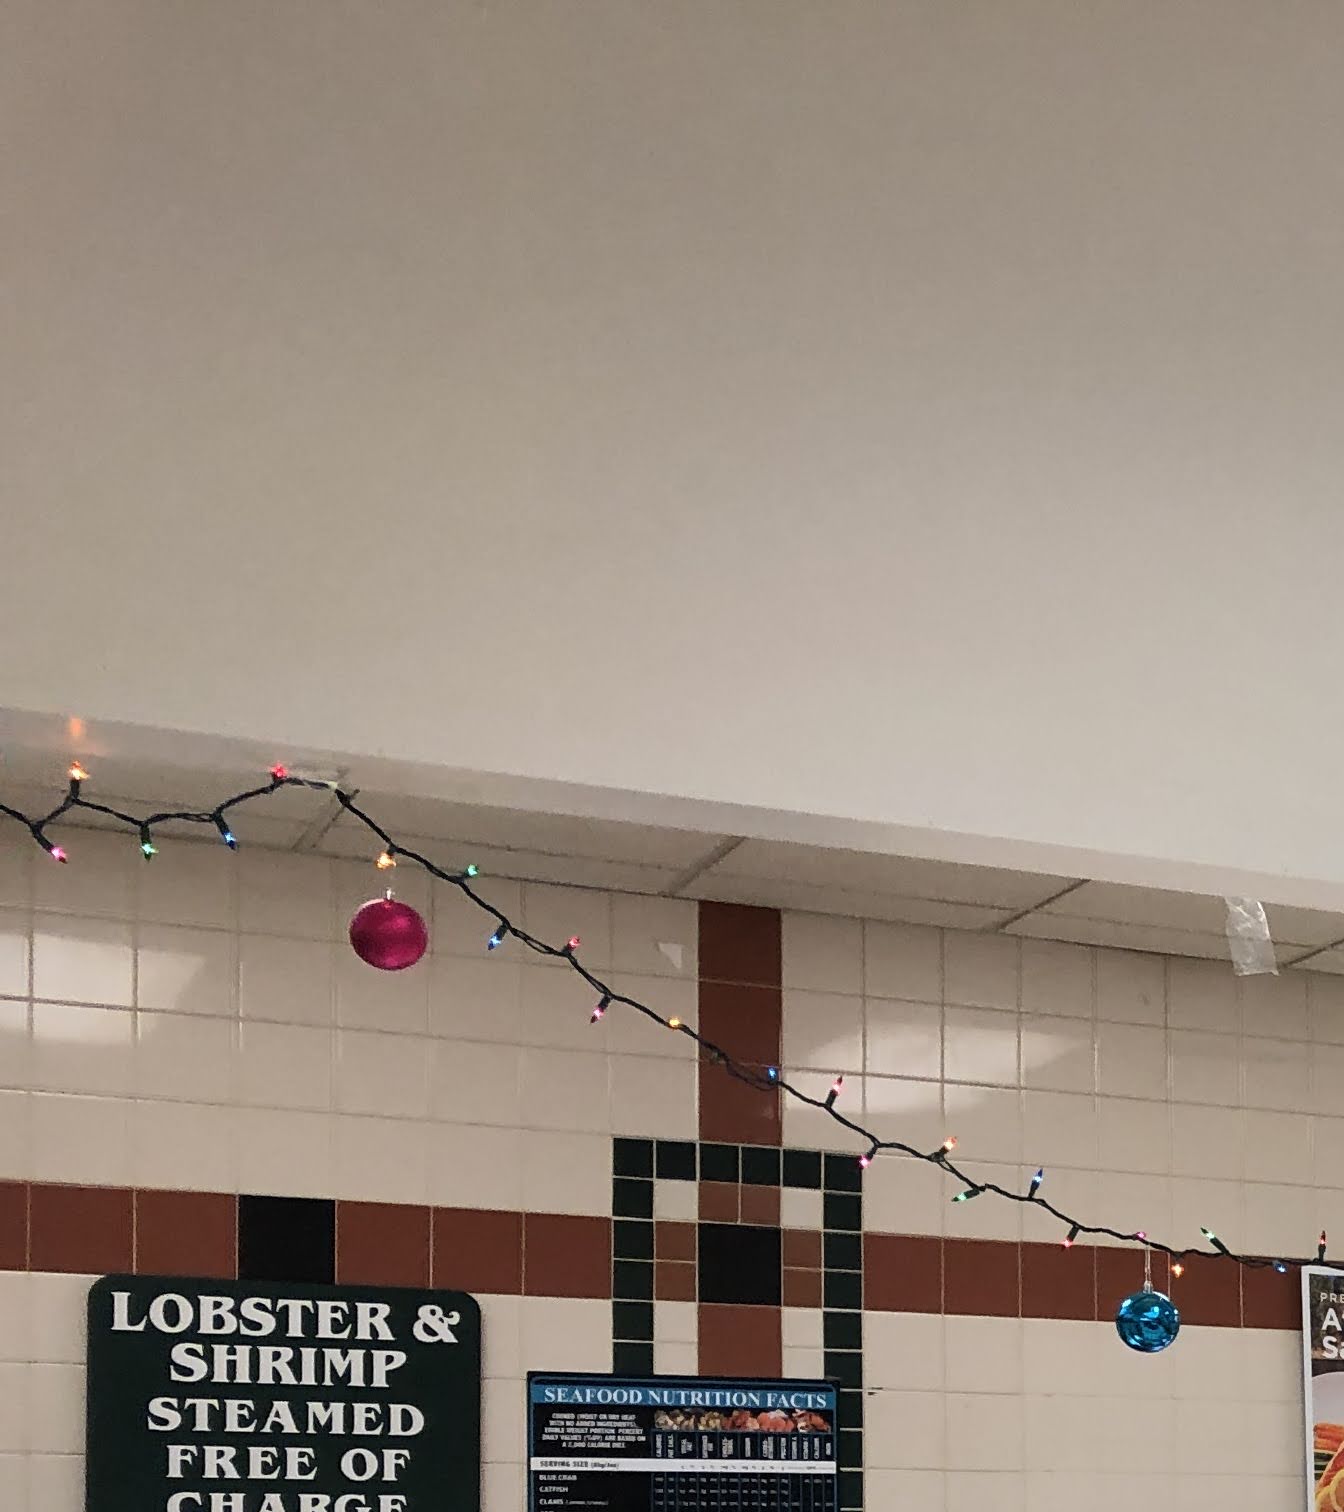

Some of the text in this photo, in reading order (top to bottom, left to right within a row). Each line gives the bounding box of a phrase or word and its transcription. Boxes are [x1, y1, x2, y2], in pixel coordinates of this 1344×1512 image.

[110, 1290, 461, 1345] LOBSTER &
[169, 1343, 408, 1389] SHRIMP
[146, 1396, 426, 1437] STEAMED
[544, 1387, 827, 1409] SEAFOOD NUTRITION FACTS
[166, 1442, 411, 1483] FREE OF
